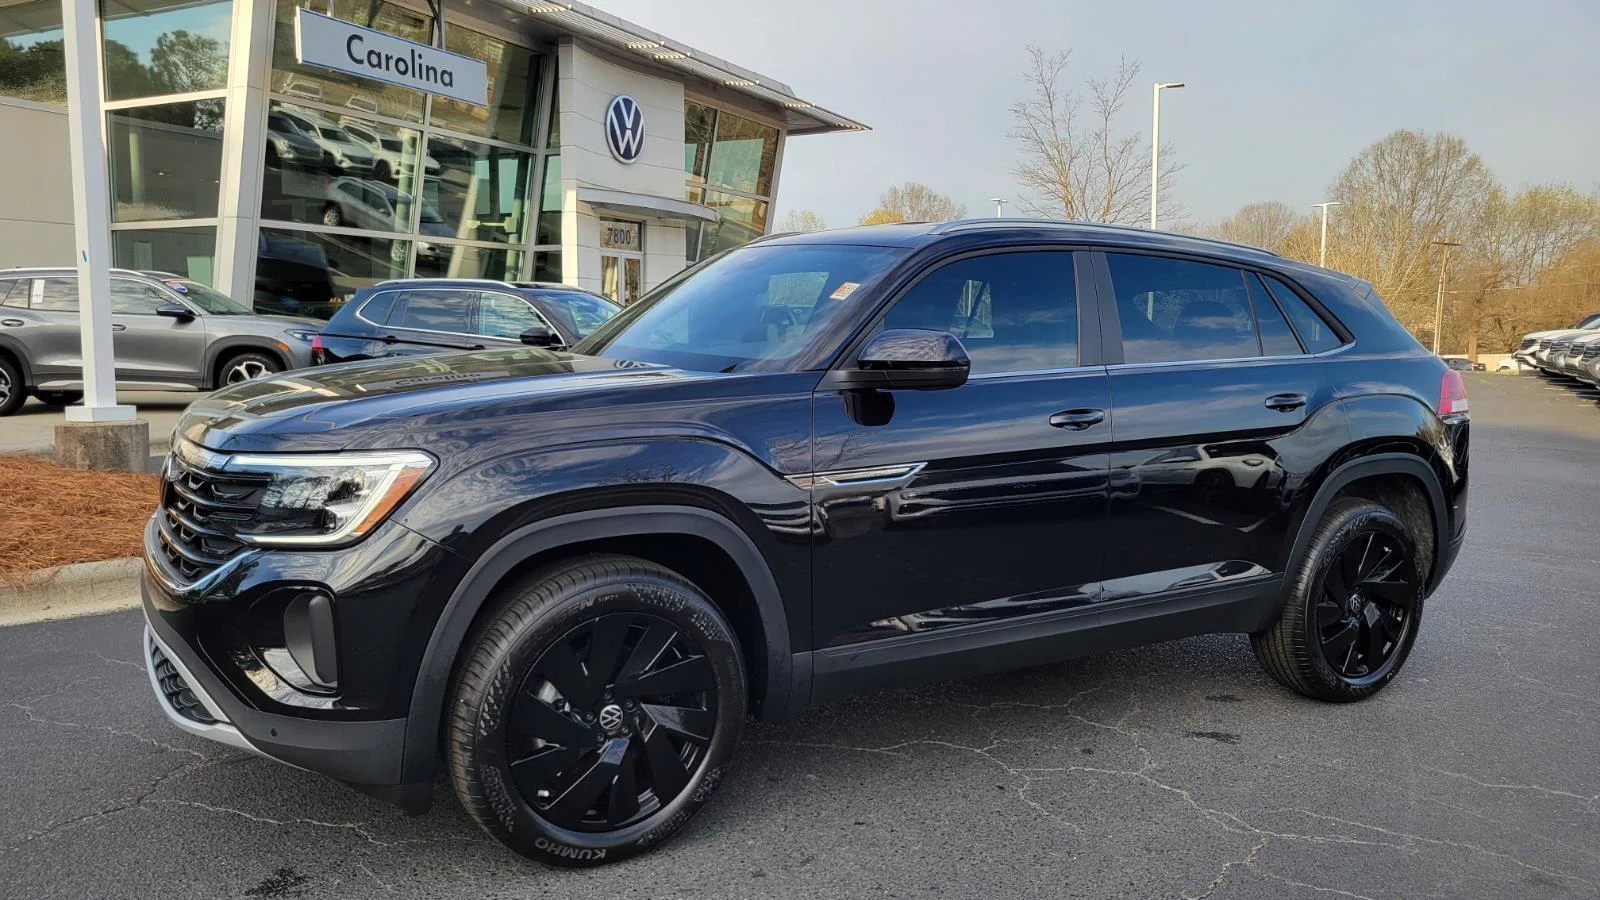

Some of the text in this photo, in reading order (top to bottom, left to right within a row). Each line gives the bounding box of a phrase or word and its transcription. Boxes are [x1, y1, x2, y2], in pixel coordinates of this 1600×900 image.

[346, 34, 453, 88] Carolina
[607, 96, 645, 163] VW
[607, 228, 631, 245] 7800
[534, 838, 607, 859] KUMHO
